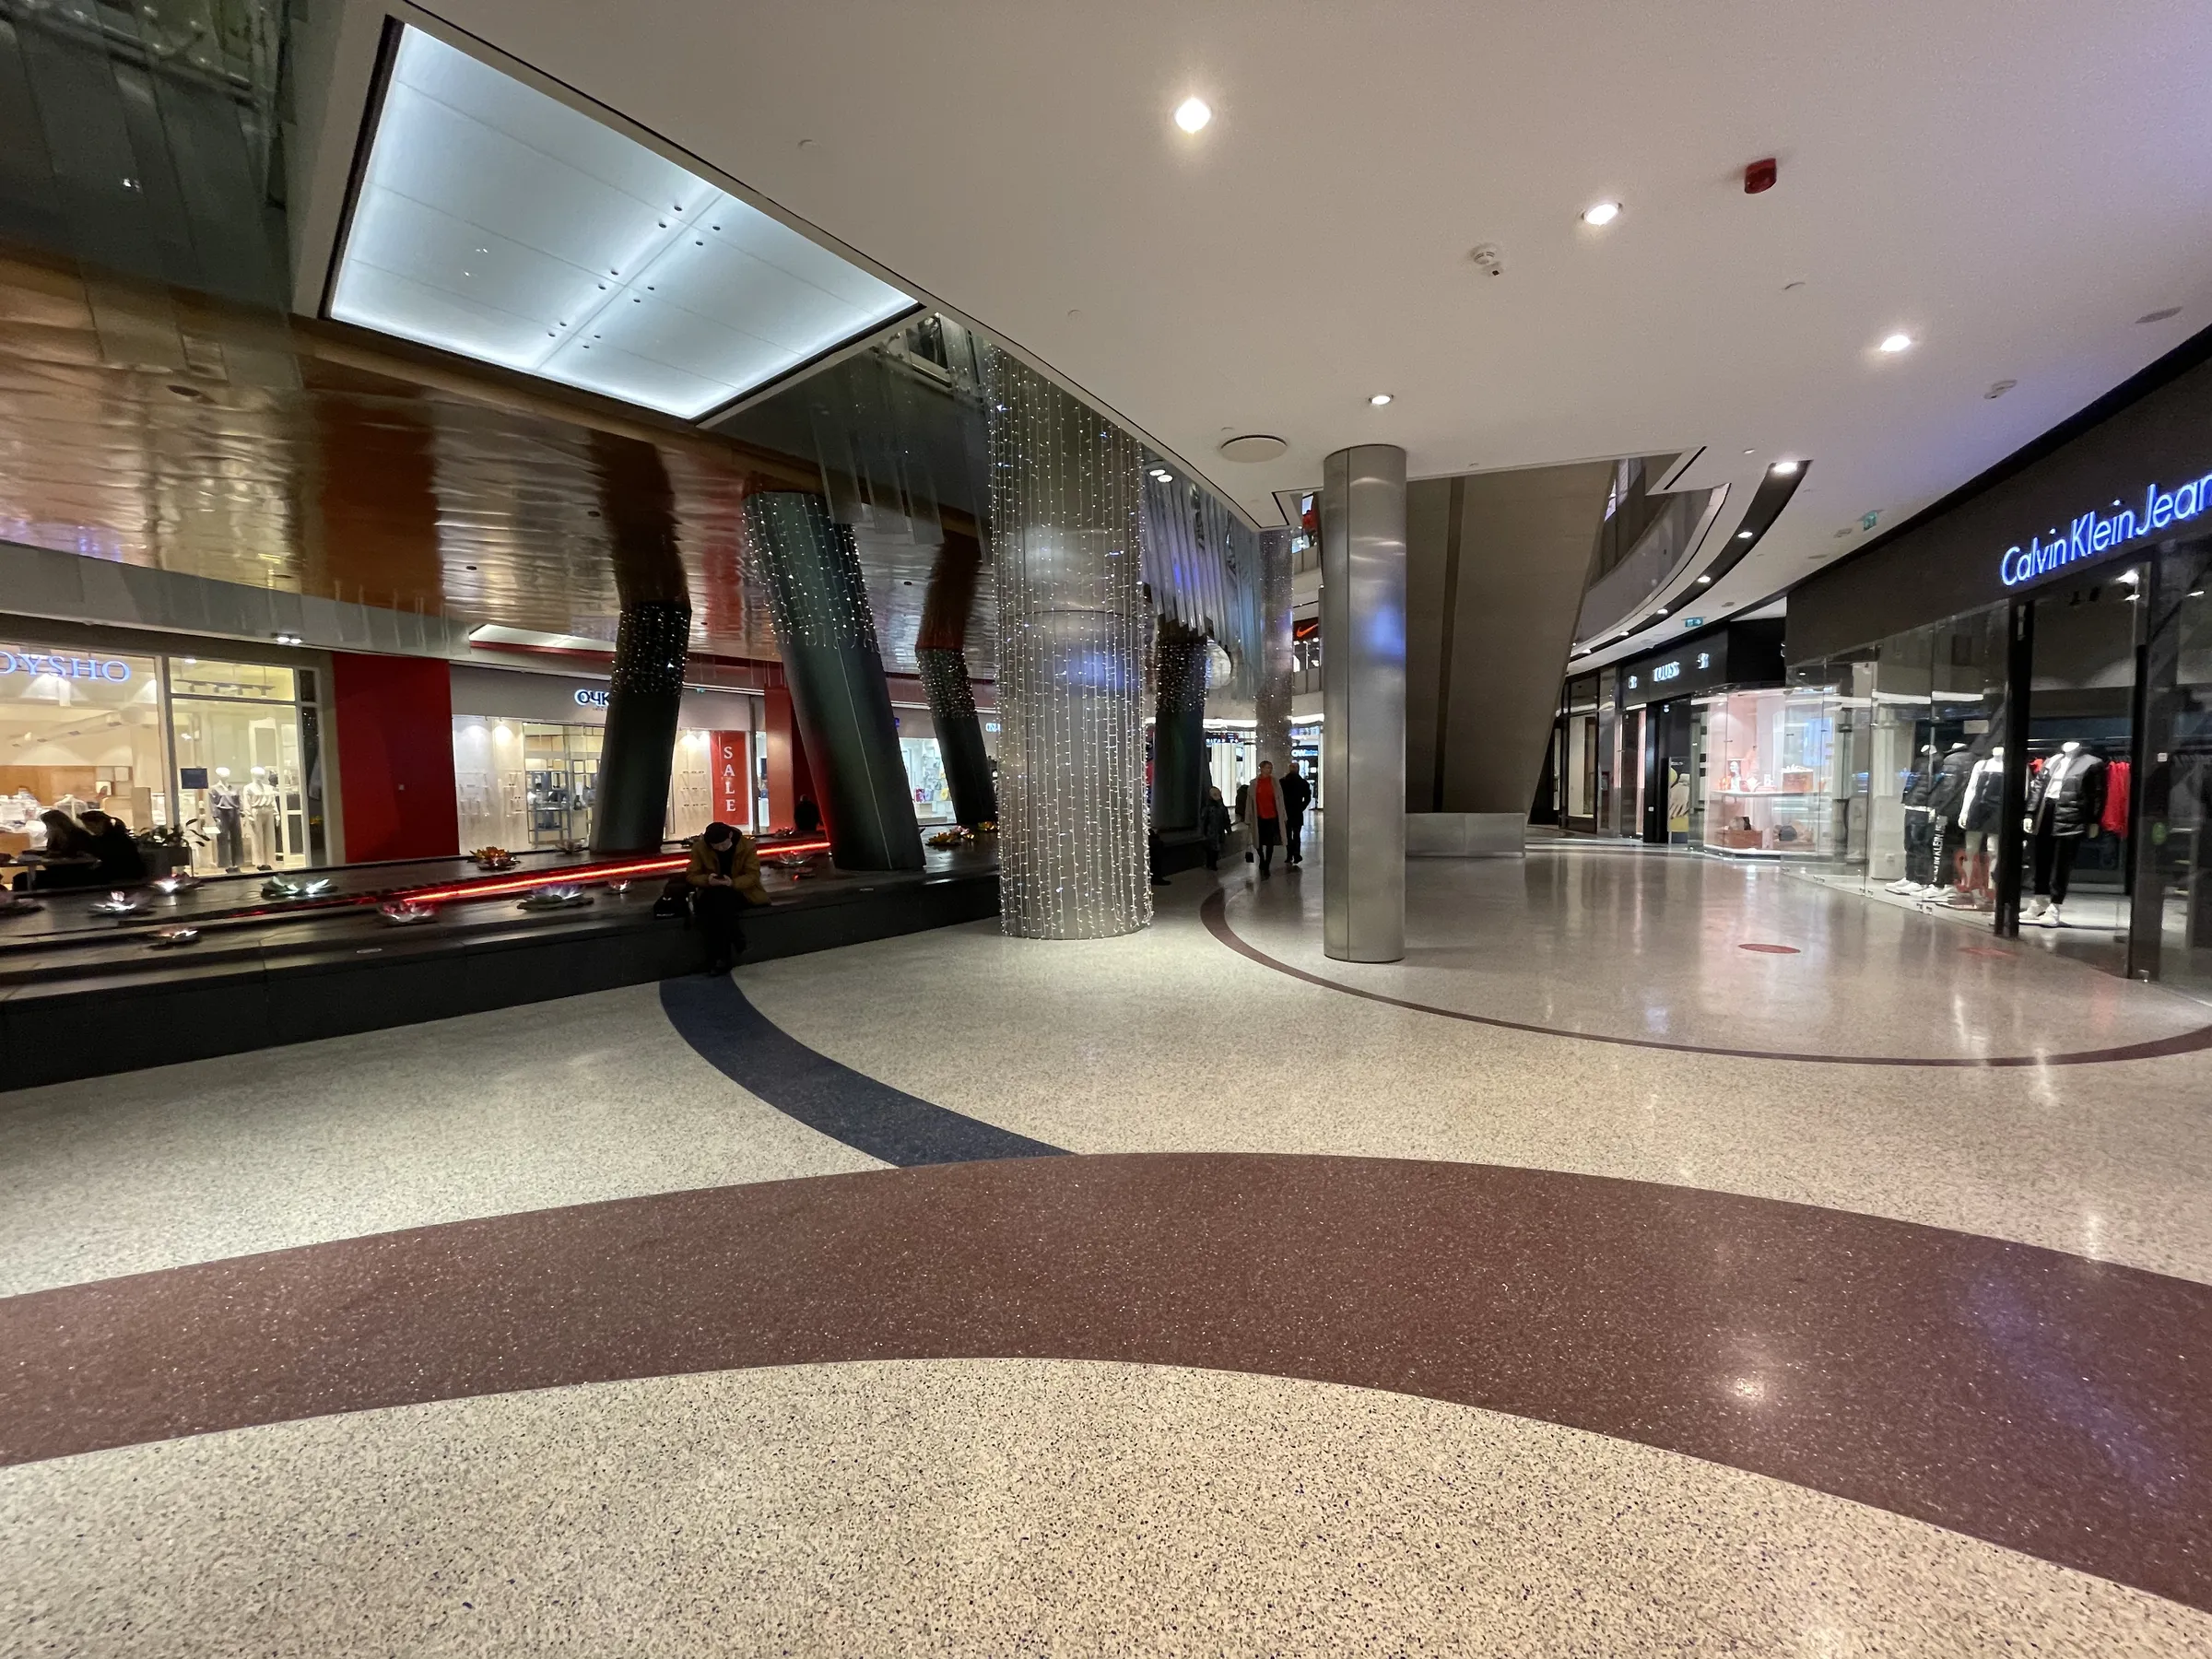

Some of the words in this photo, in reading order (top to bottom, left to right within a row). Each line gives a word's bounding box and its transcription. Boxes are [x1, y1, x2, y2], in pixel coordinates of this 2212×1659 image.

[2000, 527, 2067, 586] Calvin
[2070, 498, 2135, 561] Klein
[2135, 473, 2212, 535] Jean
[723, 746, 736, 812] SALE
